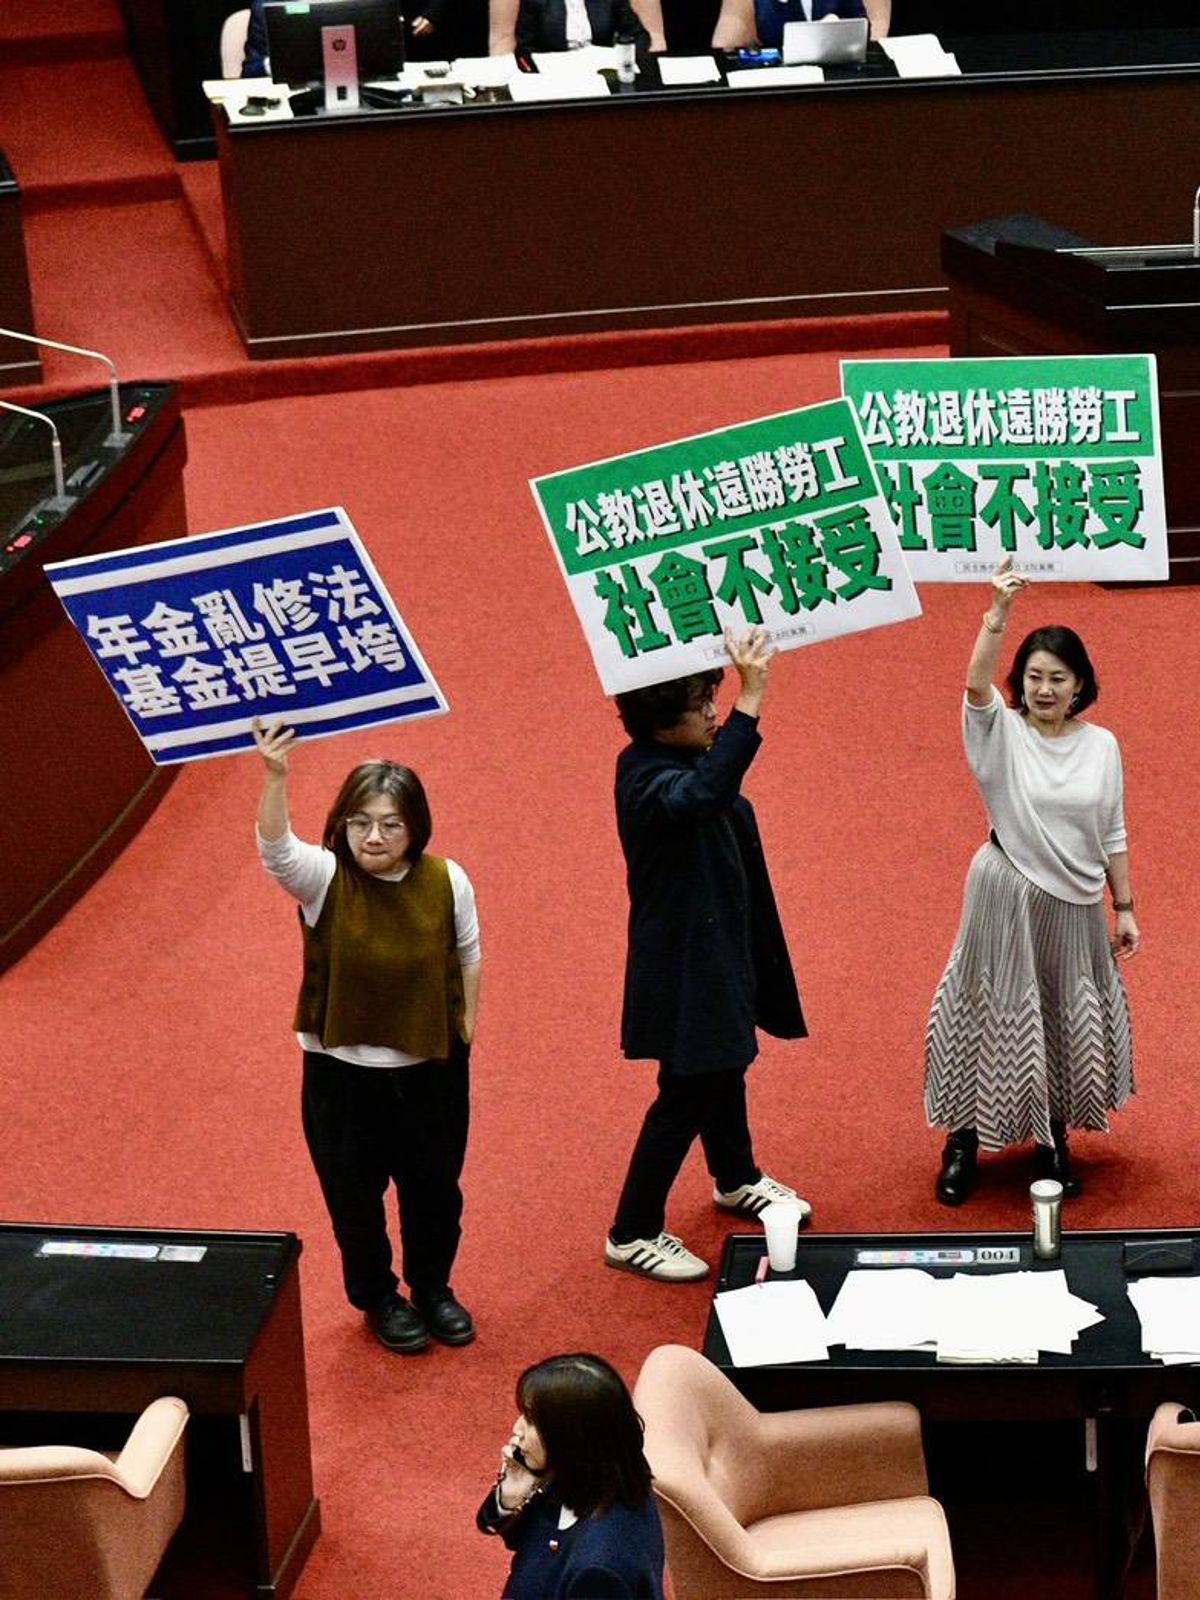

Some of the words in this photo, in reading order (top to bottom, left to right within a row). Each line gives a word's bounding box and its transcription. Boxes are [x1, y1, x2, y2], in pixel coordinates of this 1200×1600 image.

[858, 387, 1141, 447] 公教退休遠勝勞工
[565, 436, 862, 558] 公教退休遠勝勞工
[876, 459, 1149, 552] 社會不接受
[86, 564, 381, 665] 年金亂修法
[594, 504, 894, 659] 社會不接受
[112, 619, 408, 719] 基金提早垮
